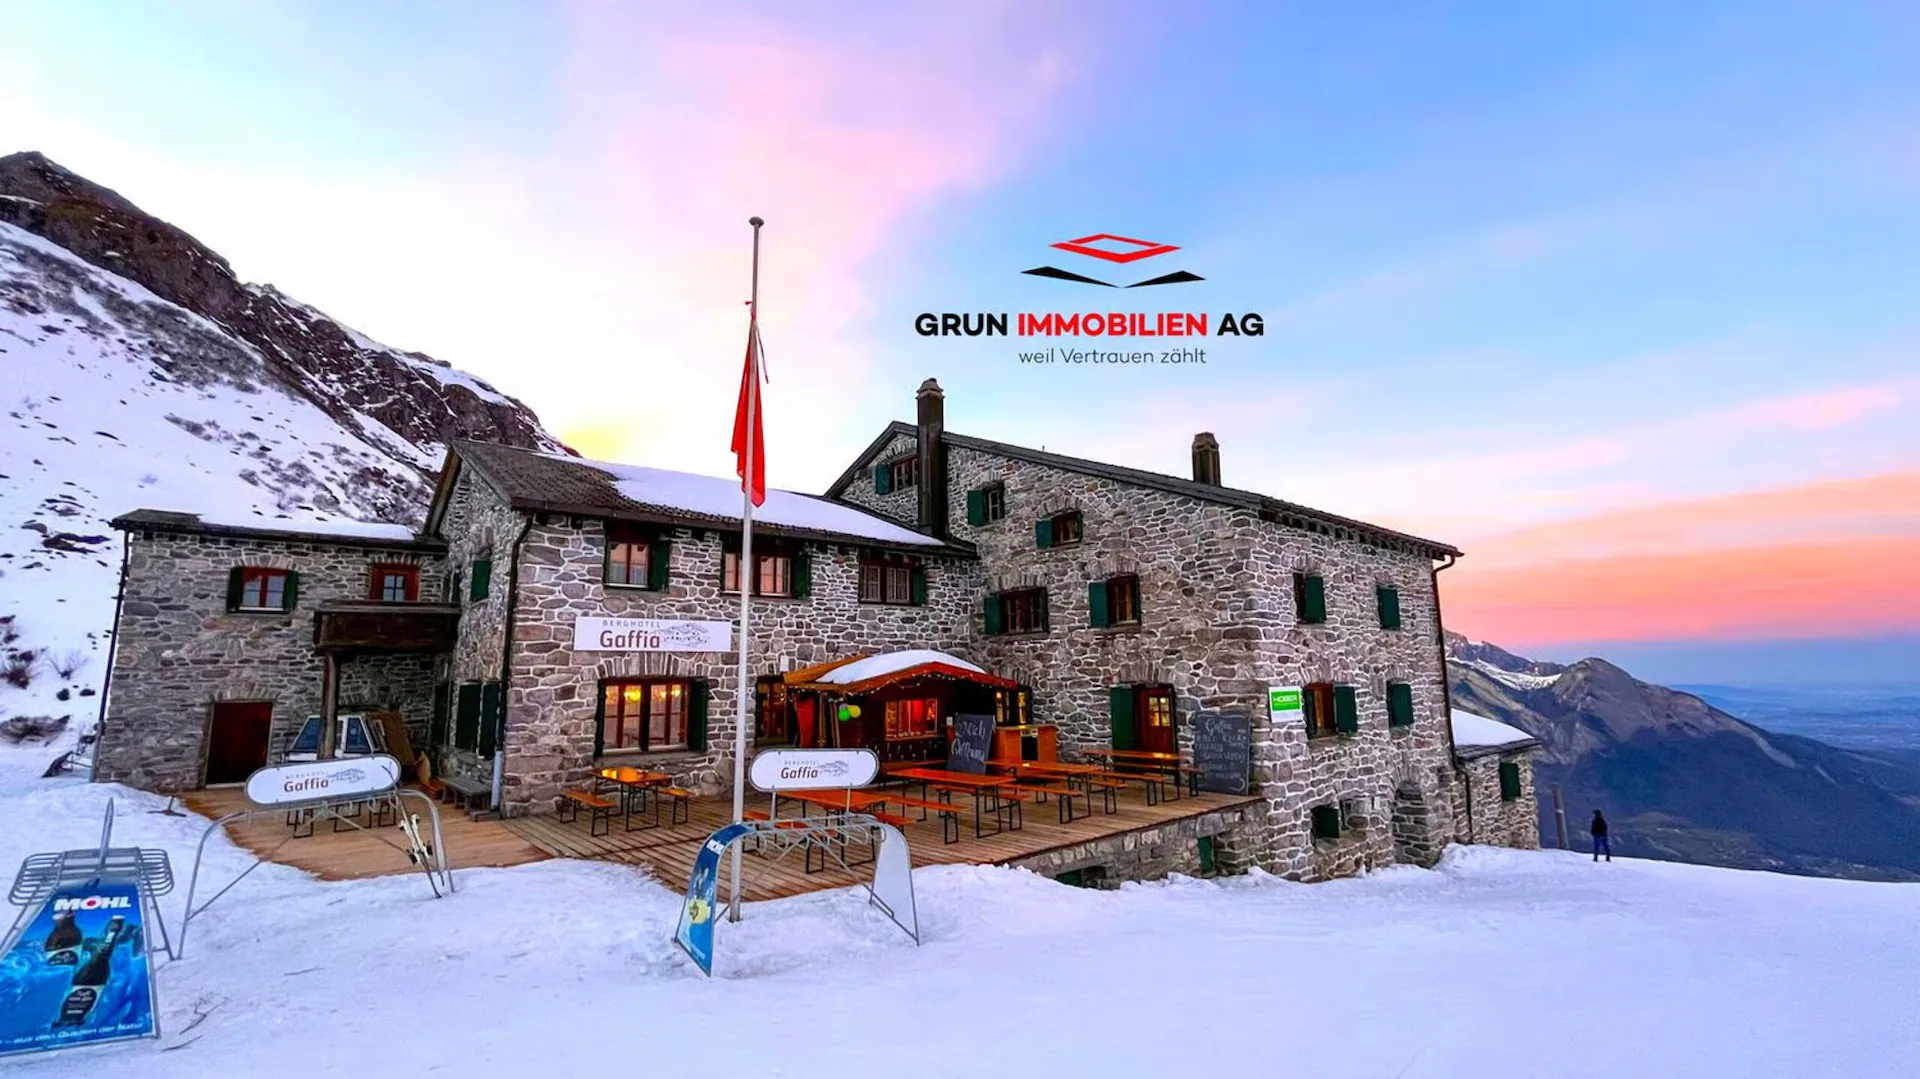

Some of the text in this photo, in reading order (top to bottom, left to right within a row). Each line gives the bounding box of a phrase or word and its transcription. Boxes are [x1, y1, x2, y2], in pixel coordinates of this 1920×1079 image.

[602, 619, 661, 629] BERGHOTEL
[599, 630, 660, 649] Gaffia
[780, 766, 819, 779] Gaffia
[283, 777, 329, 793] Gaffia
